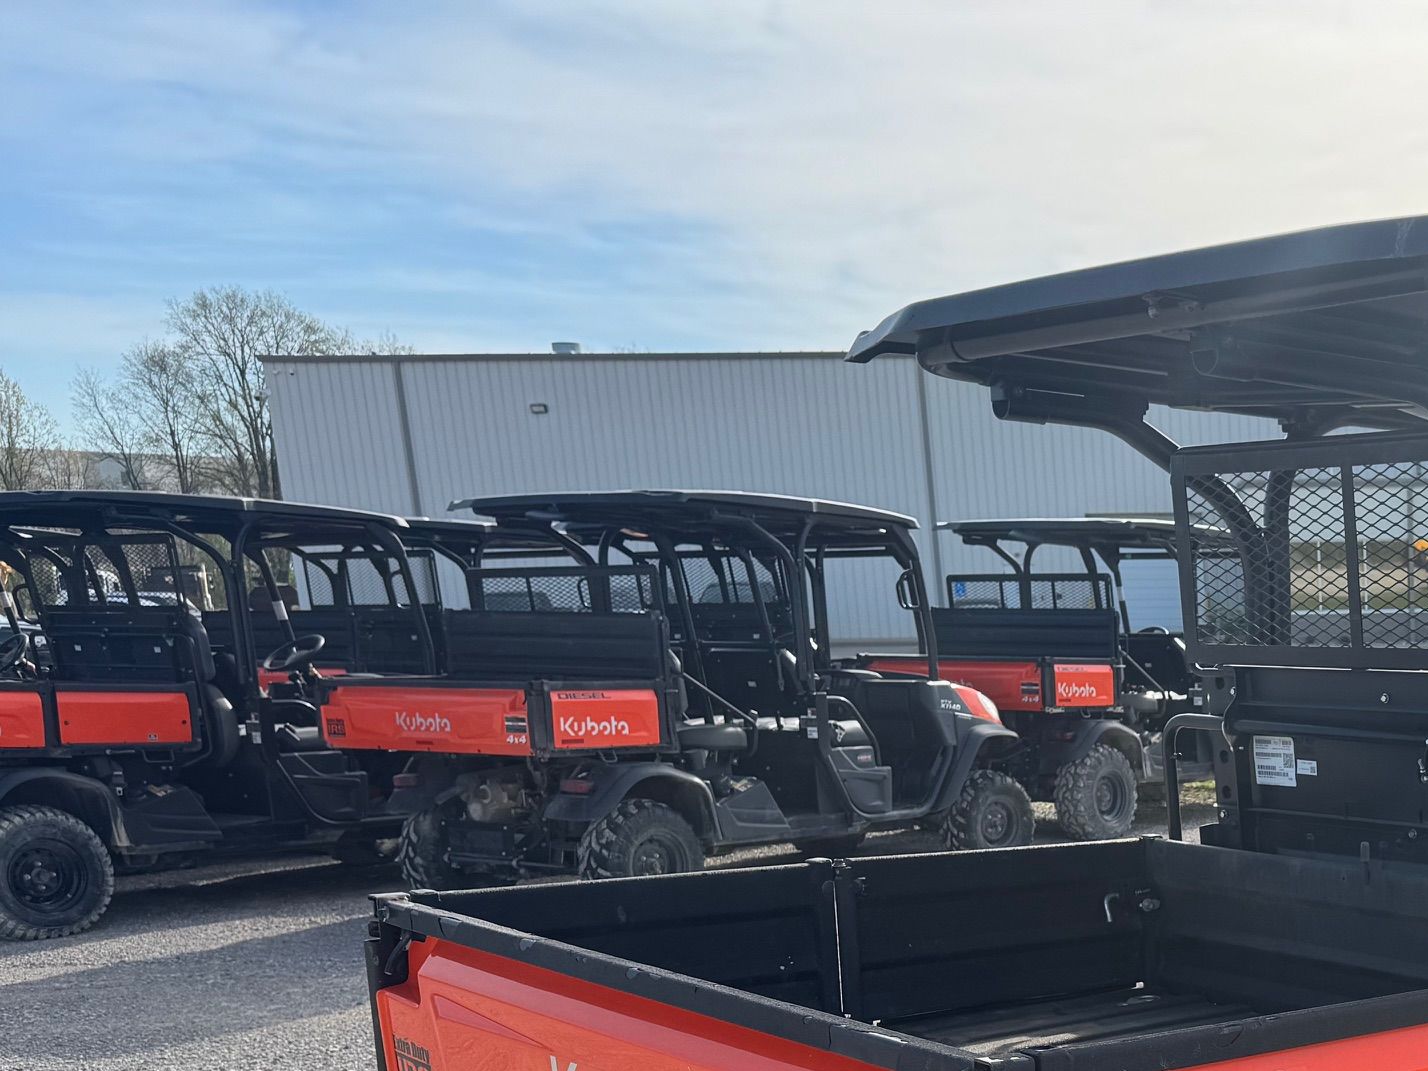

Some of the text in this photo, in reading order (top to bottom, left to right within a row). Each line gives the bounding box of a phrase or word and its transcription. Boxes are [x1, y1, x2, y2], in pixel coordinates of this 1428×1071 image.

[1057, 682, 1096, 697] Kubota
[395, 711, 451, 732] Kubota
[560, 716, 630, 736] Kubota
[506, 735, 527, 744] 4x4
